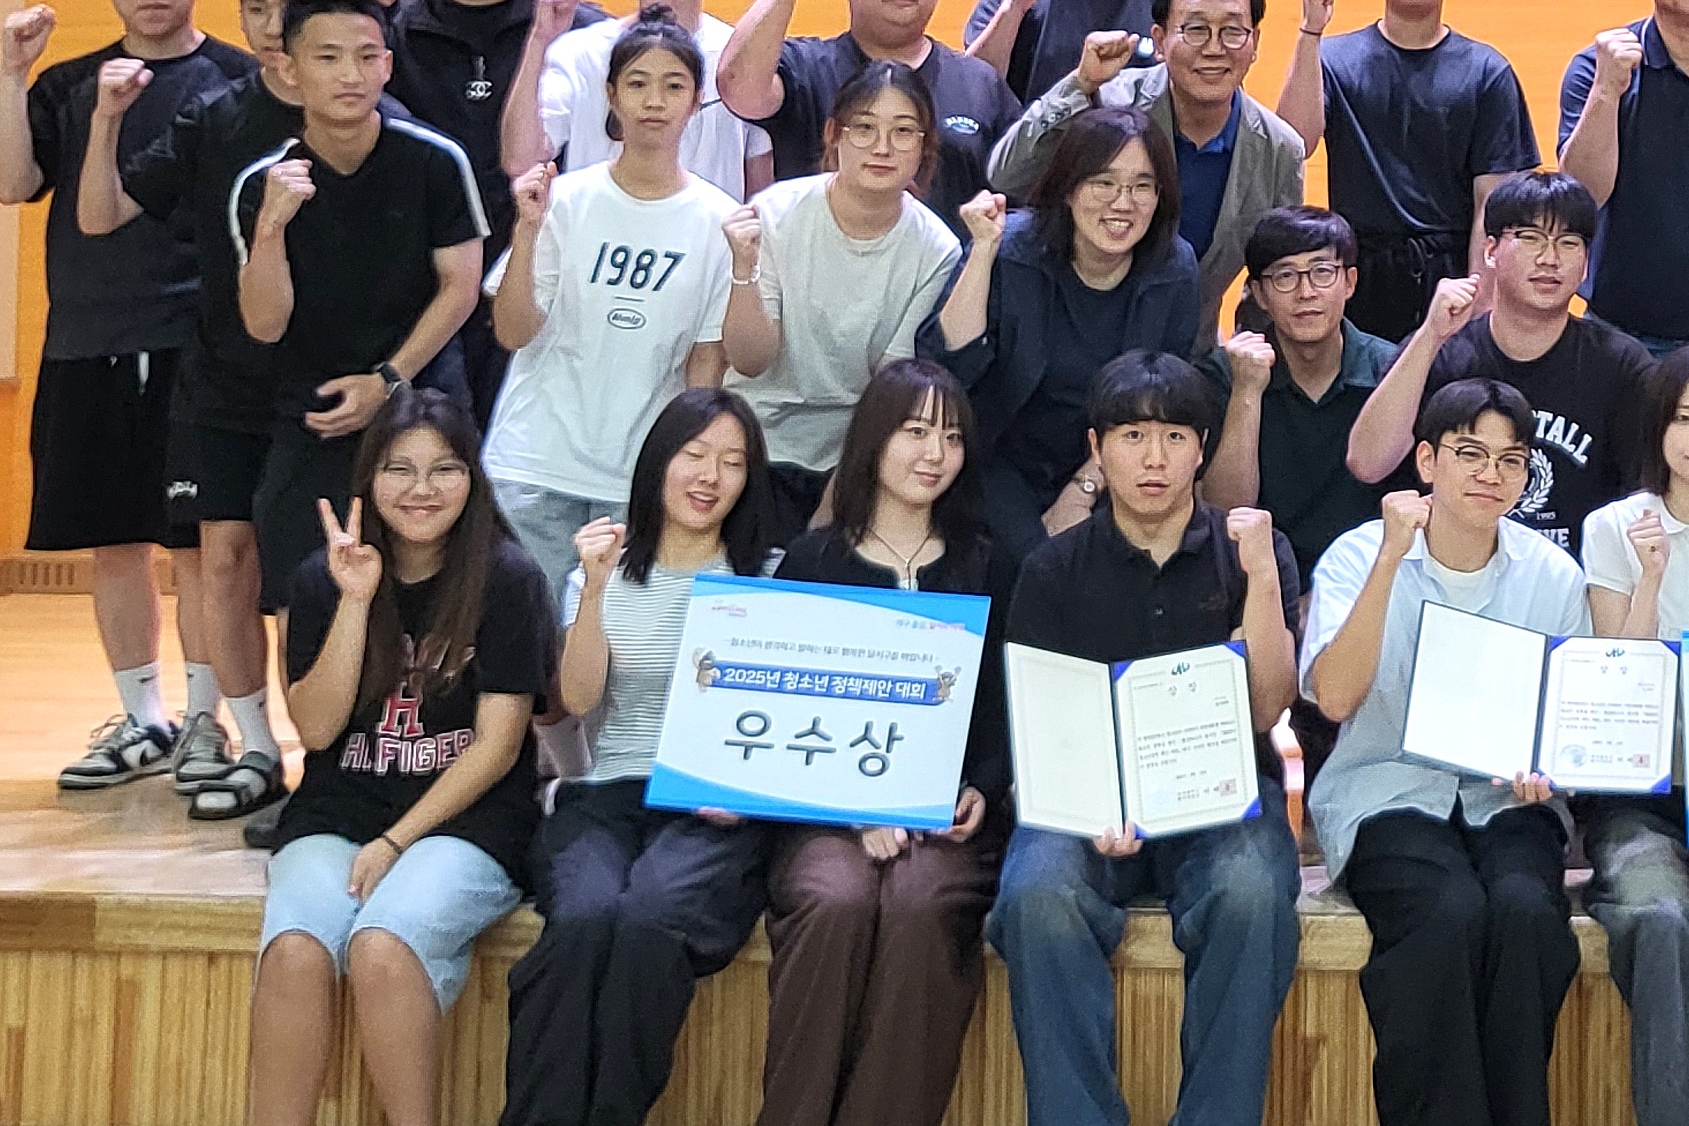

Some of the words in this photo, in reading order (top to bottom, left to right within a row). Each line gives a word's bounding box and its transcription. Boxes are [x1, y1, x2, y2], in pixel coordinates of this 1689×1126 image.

[589, 242, 686, 291] 1987
[1533, 410, 1592, 464] TALL
[723, 667, 781, 688] 2025년
[782, 670, 829, 692] 청소년
[895, 680, 926, 700] 대회
[341, 728, 475, 776] HFIGER
[724, 708, 904, 777] 우수상
